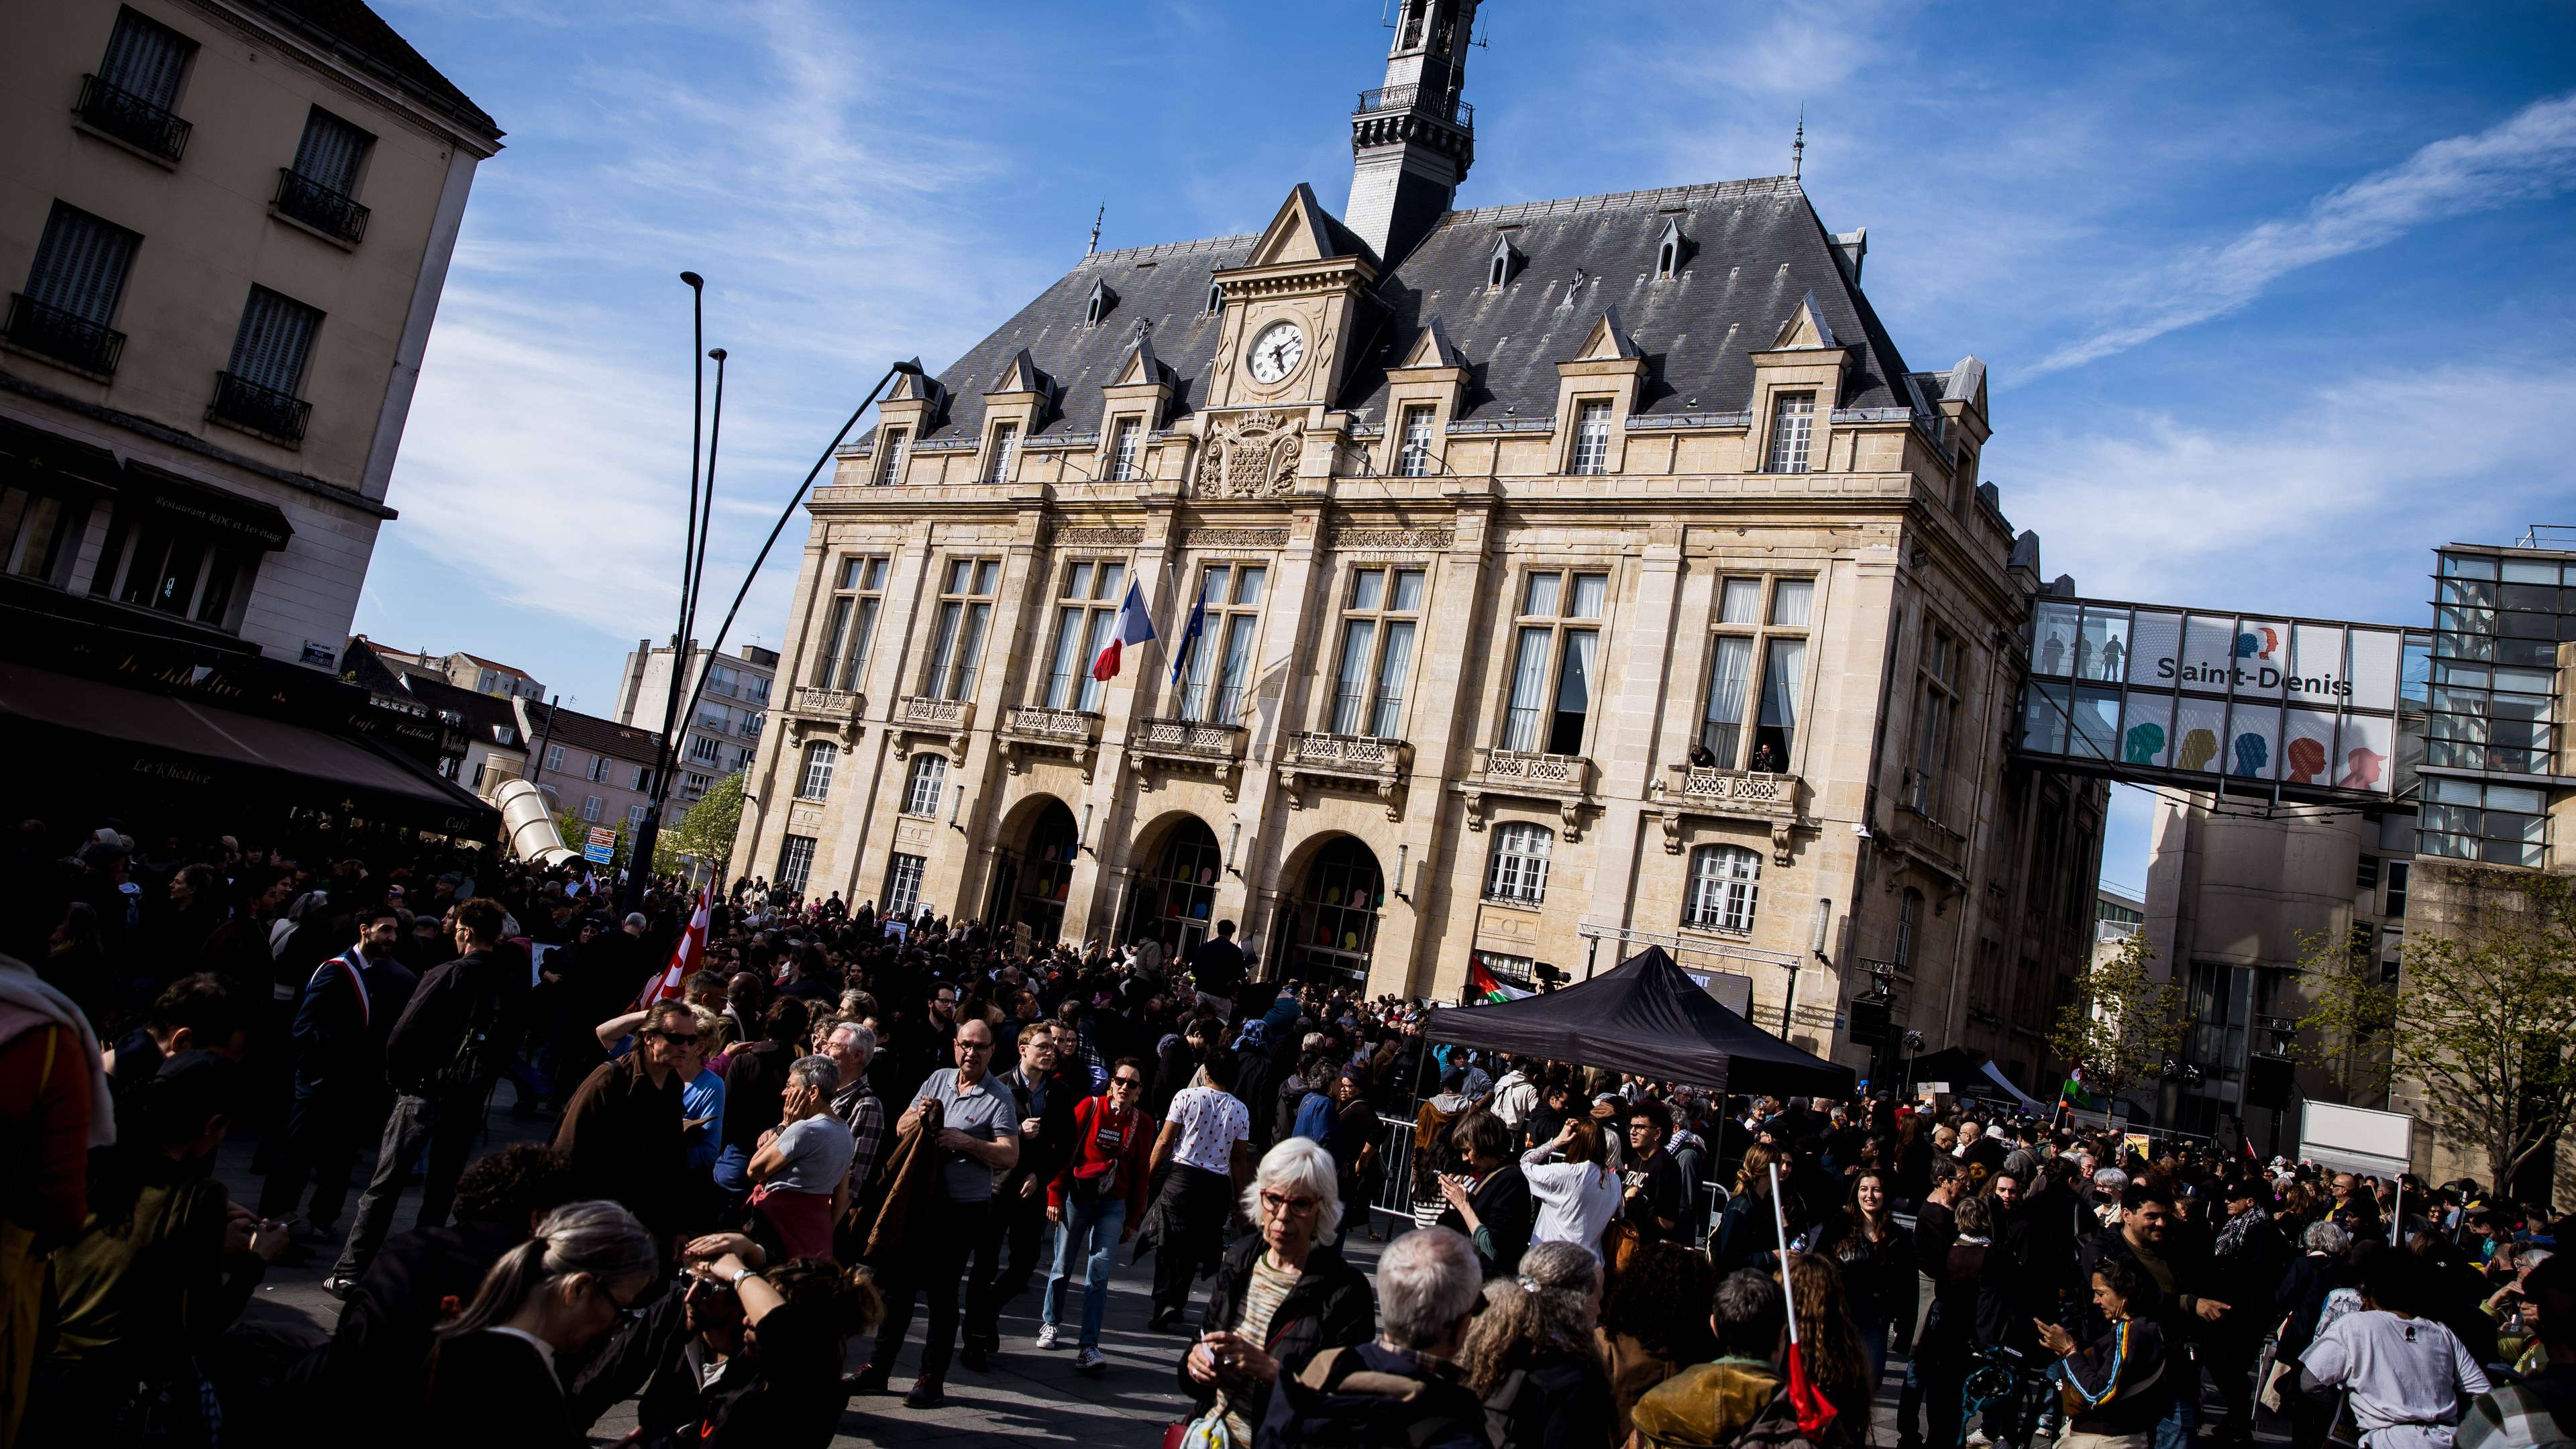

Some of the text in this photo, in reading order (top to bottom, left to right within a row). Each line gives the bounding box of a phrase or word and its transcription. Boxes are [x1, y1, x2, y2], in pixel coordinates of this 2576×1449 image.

[156, 496, 206, 519] Restaurant
[209, 512, 233, 527] RDC
[233, 521, 242, 529] et
[2157, 656, 2353, 697] Saint-Denis
[132, 757, 153, 773] Le
